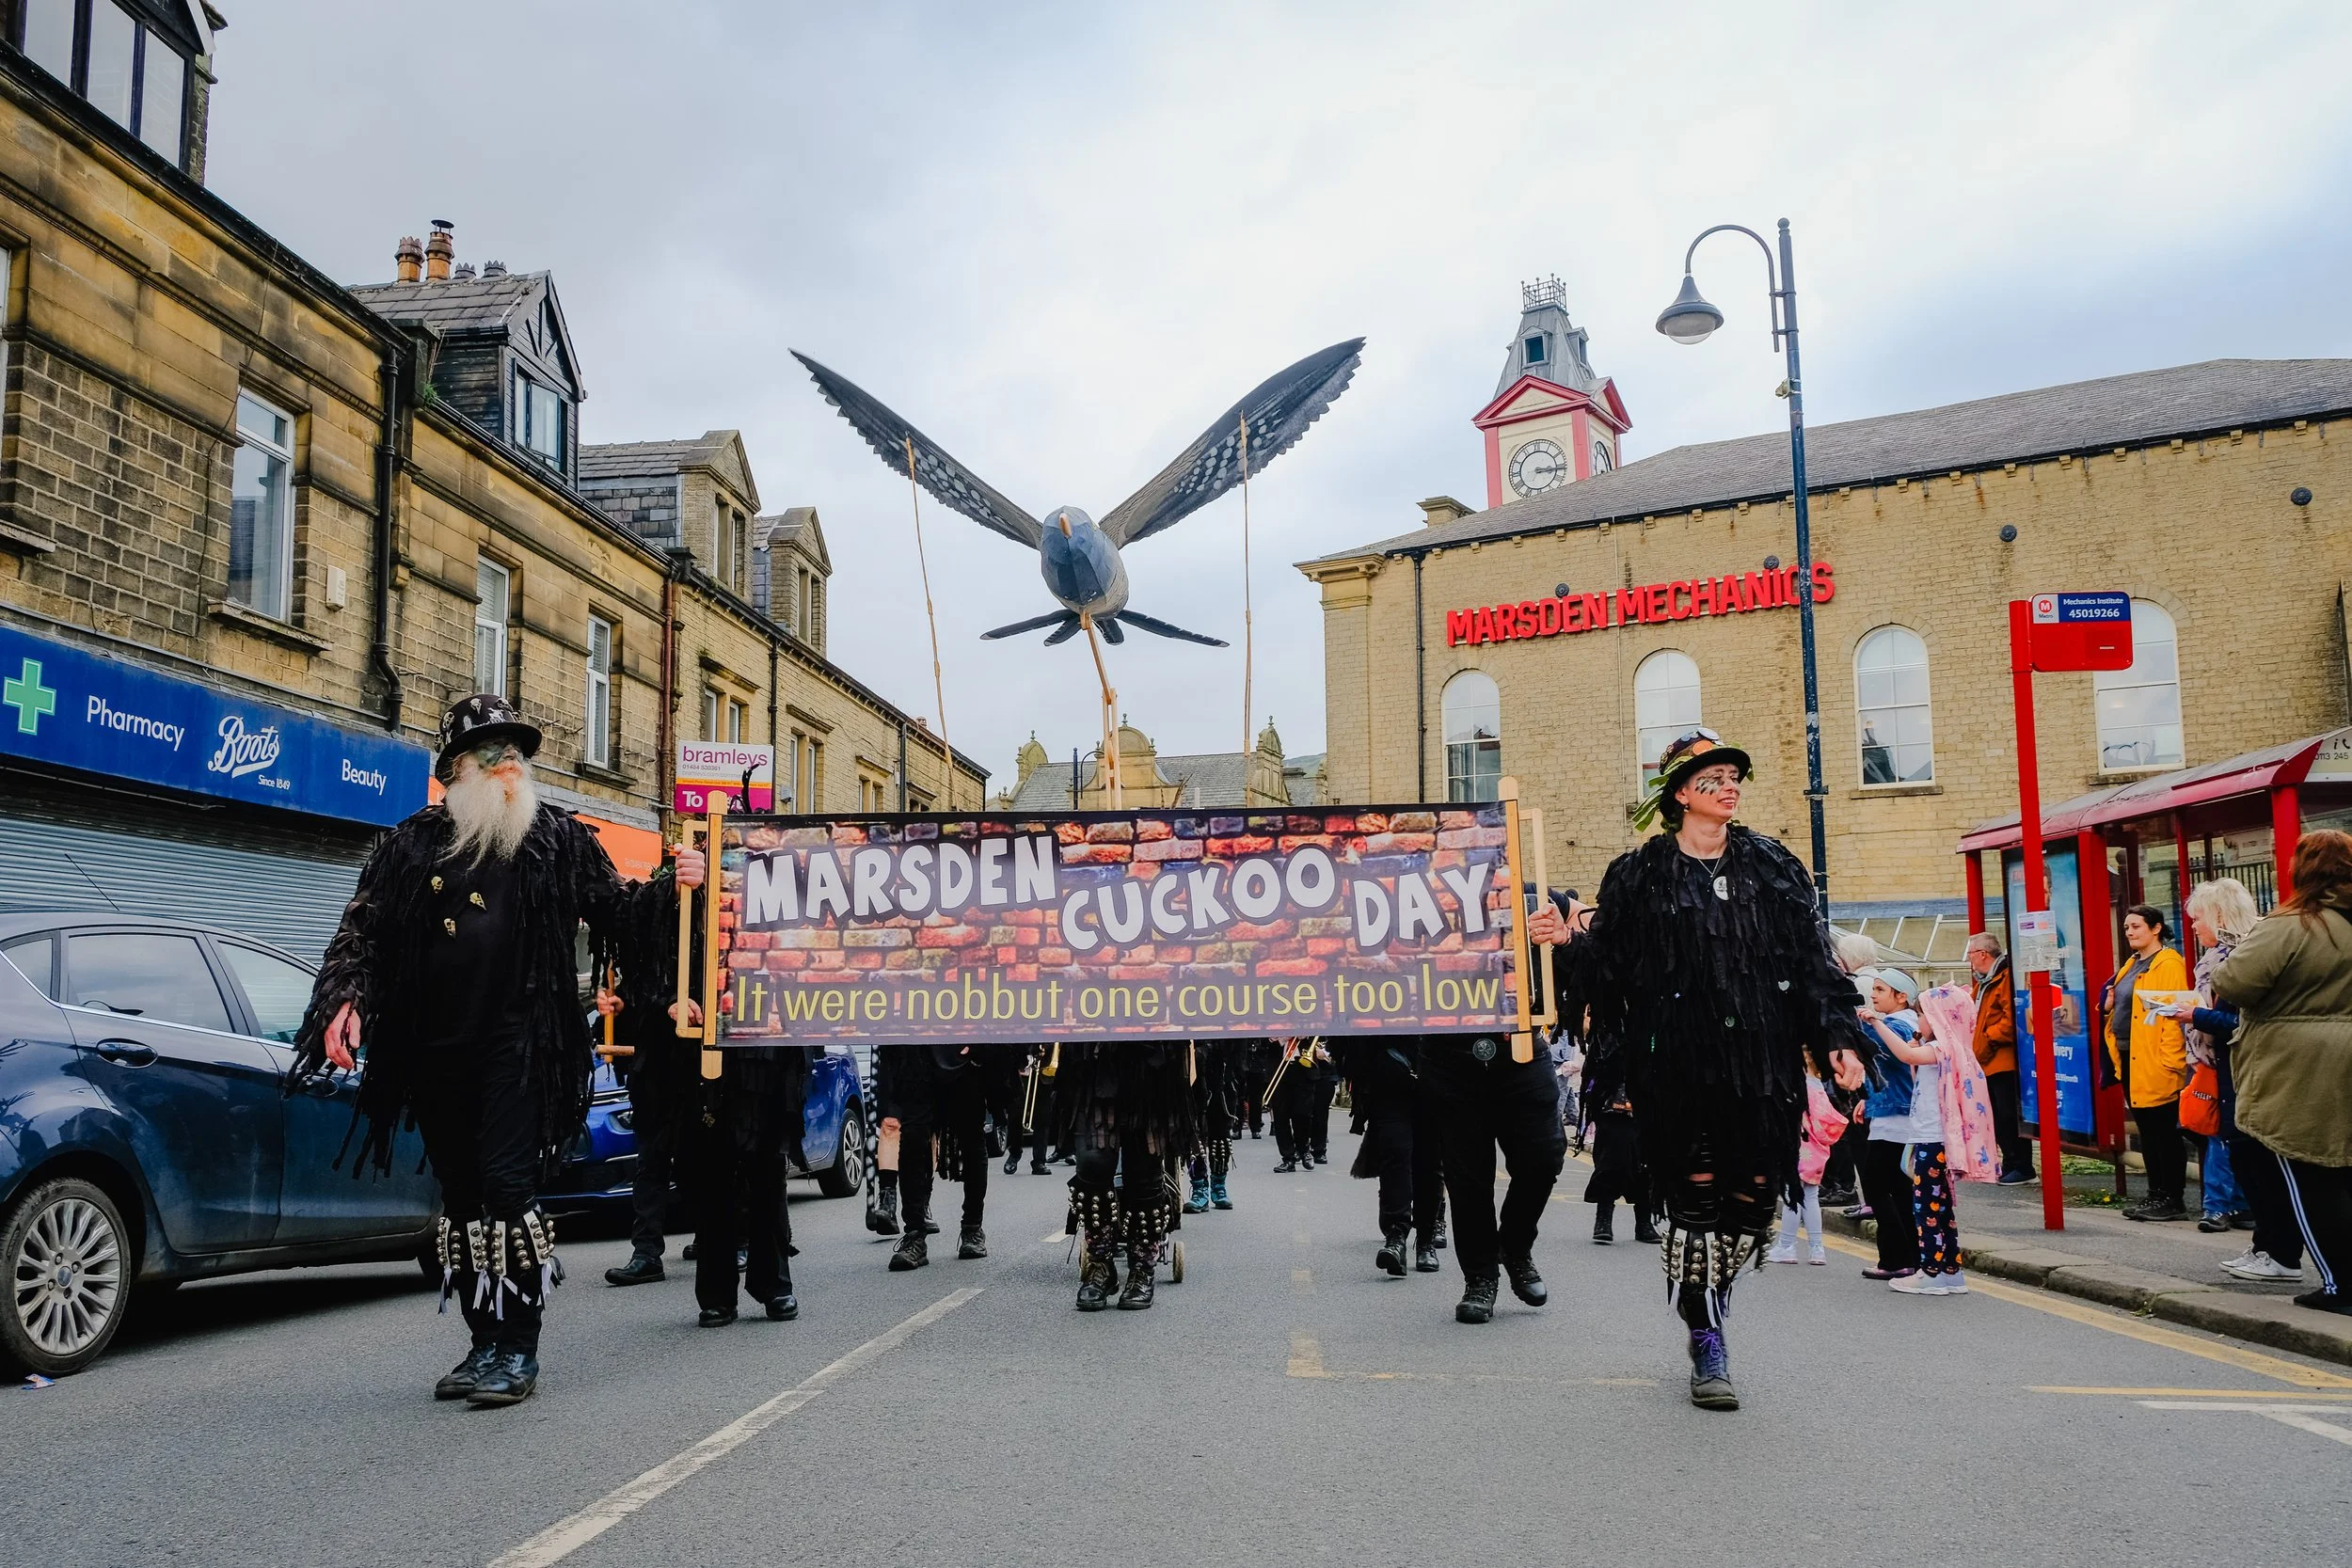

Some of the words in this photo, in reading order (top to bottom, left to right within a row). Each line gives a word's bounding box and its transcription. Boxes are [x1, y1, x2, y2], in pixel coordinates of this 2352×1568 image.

[1446, 591, 1608, 647] MARSDEN
[1615, 561, 1836, 626] MECHANICS
[2069, 609, 2121, 618] 45019266
[87, 694, 185, 752] Pharmacy
[207, 715, 280, 779] Boots
[258, 774, 276, 788] Since
[276, 778, 291, 790] 1849
[342, 758, 387, 796] Beauty
[683, 746, 768, 769] bramleys
[682, 790, 704, 808] To
[745, 835, 1057, 925] MARSDEN
[1062, 847, 1336, 951] CUCKOO
[1353, 863, 1489, 947] DAY
[737, 975, 768, 1022] It
[783, 988, 888, 1022] were
[907, 972, 1063, 1021] nobbut
[1080, 985, 1159, 1019] one
[1178, 982, 1316, 1017] course
[1334, 974, 1404, 1013] too
[1422, 964, 1499, 1011] low
